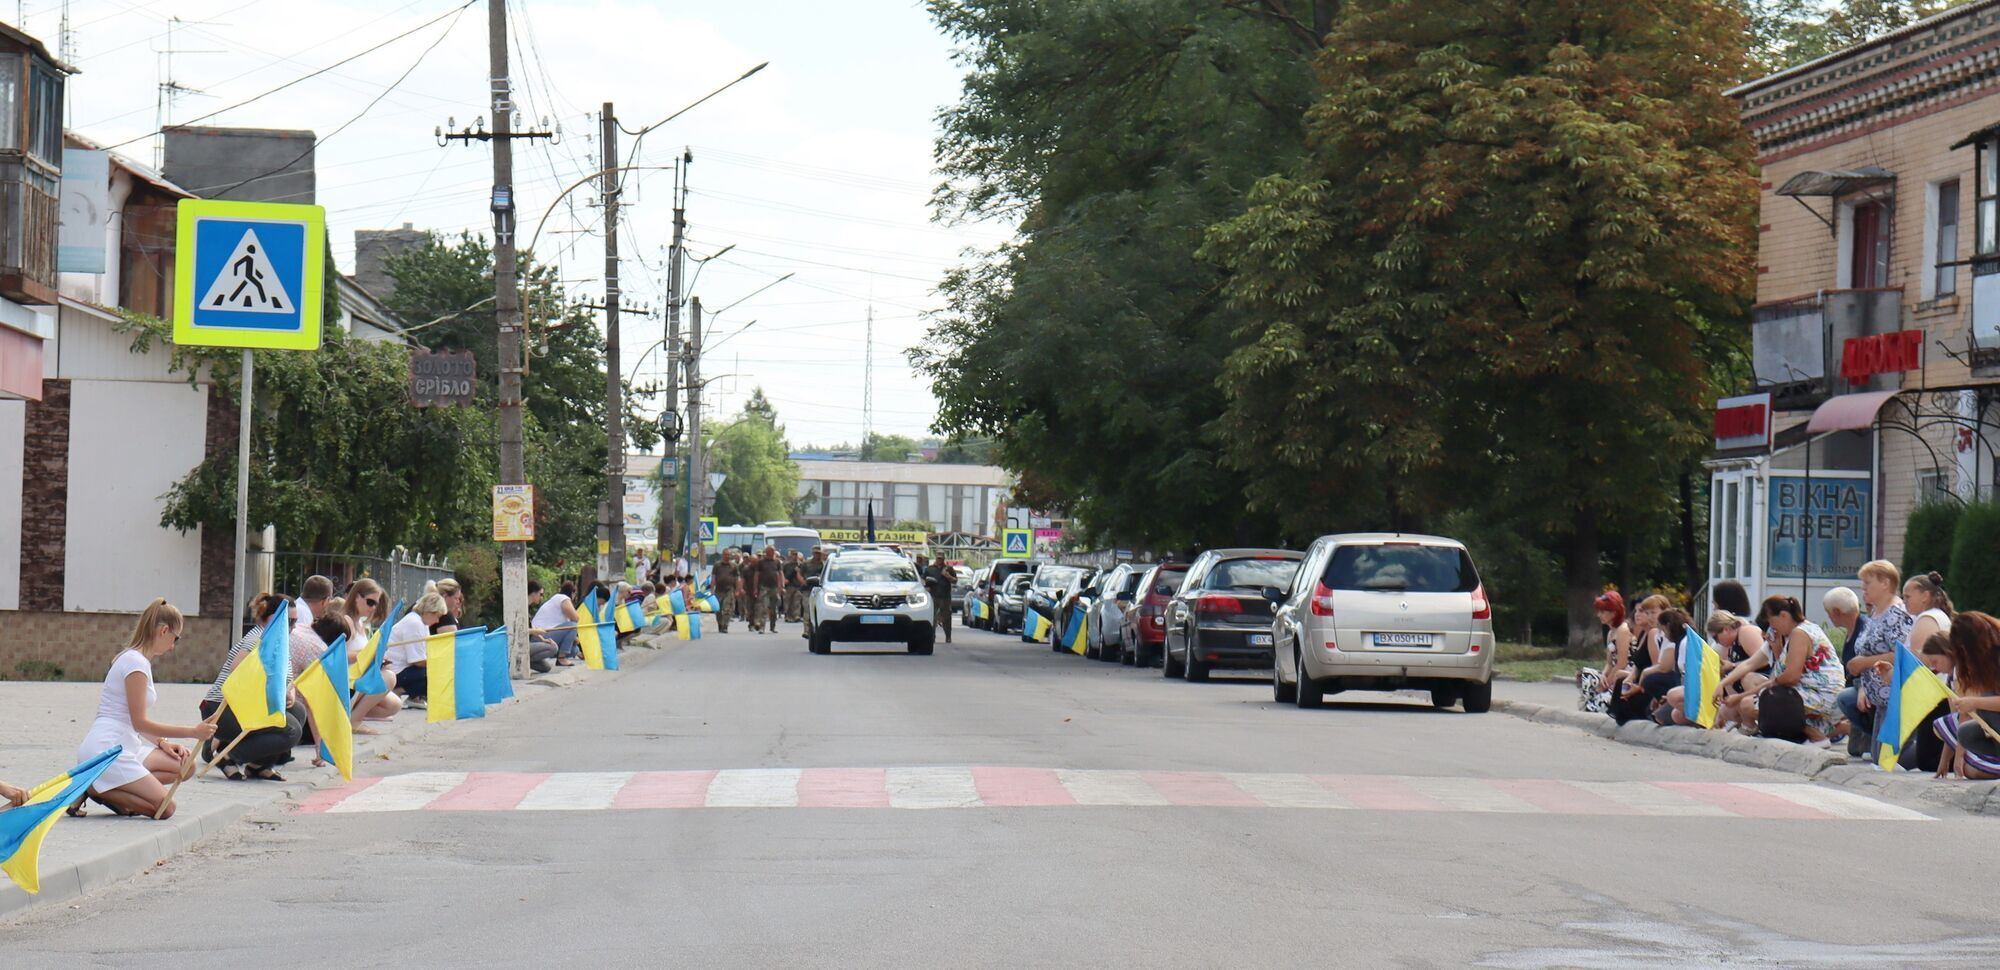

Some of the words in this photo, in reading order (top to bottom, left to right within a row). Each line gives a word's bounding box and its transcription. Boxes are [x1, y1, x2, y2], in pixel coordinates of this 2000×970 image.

[415, 360, 473, 375] ЗОЛОТО
[415, 376, 470, 396] СРІБЛО
[1779, 483, 1860, 509] ВІКНА
[829, 531, 915, 541] АВТОГАЗИН
[1776, 513, 1859, 543] ДВЕРІ
